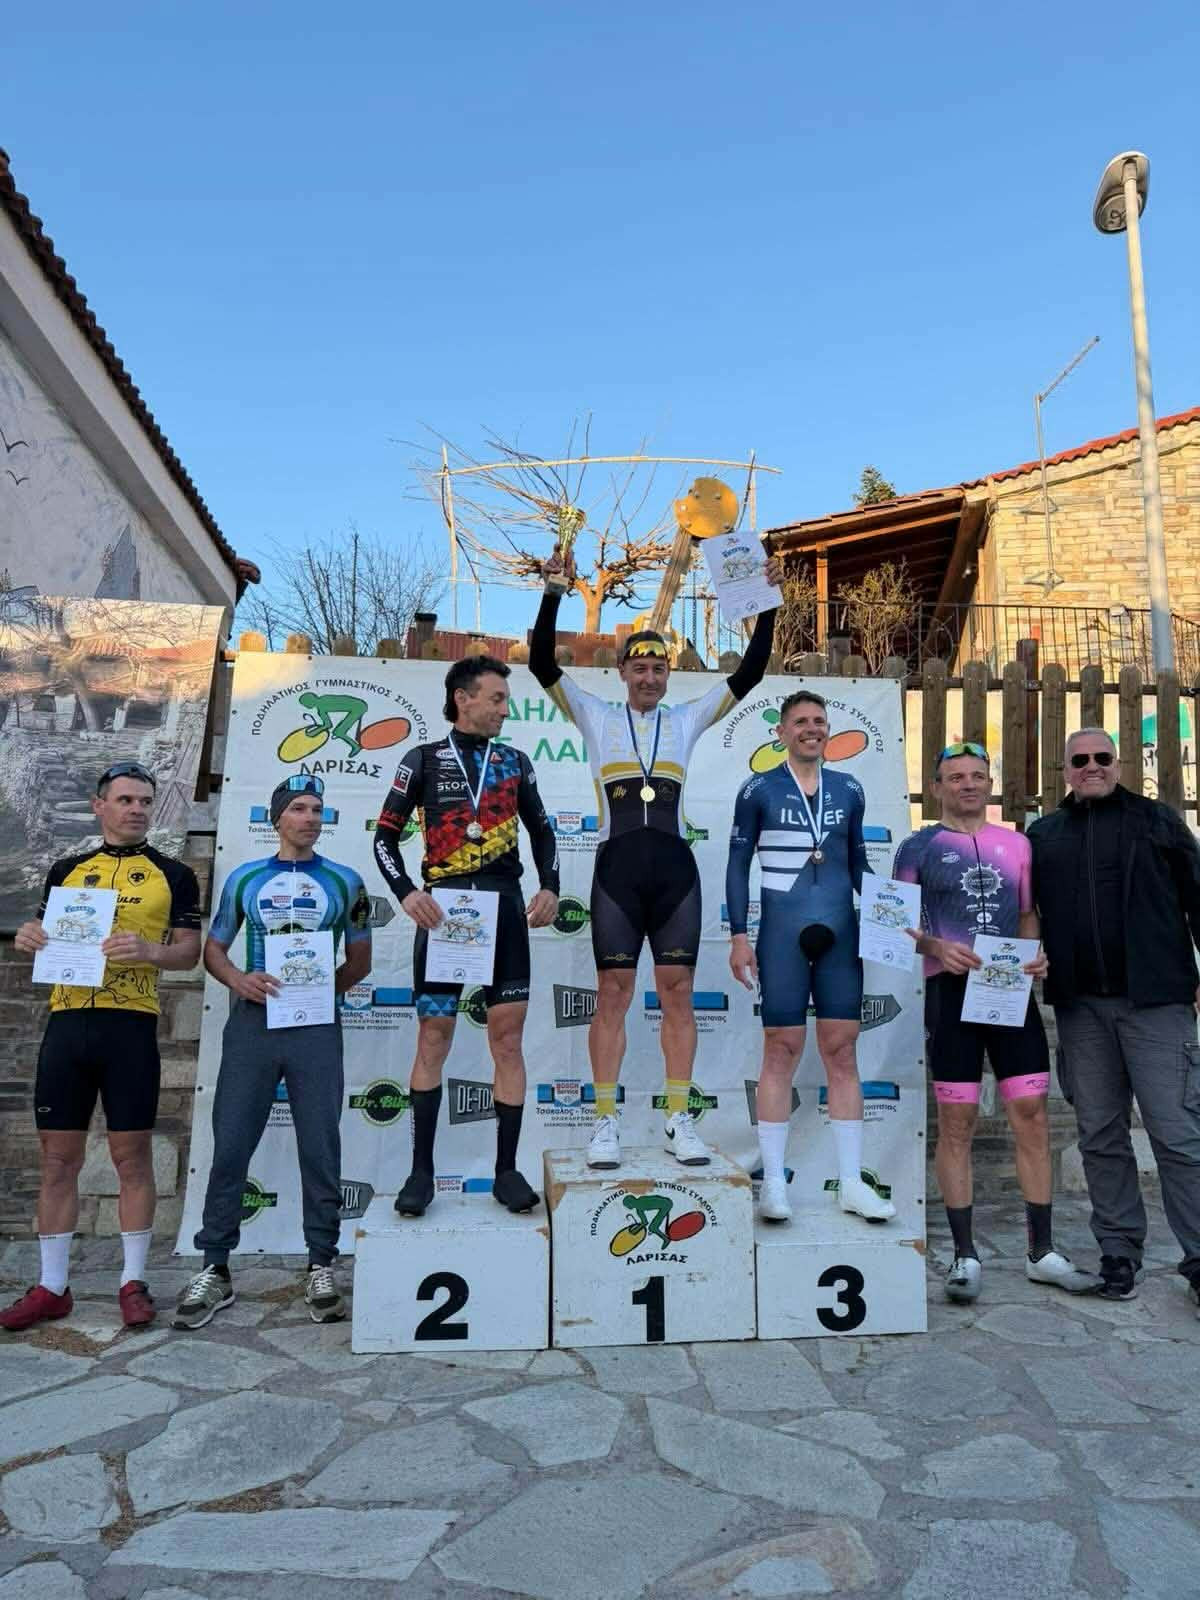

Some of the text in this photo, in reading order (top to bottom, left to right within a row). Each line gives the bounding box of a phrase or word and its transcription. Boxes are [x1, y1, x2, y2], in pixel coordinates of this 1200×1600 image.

[252, 679, 428, 741] ΠΟΔΗΛΑΤΙΚΟΣ ΓΥΜΝΑΣΤΙΚΟΣ ΣΥΛΛΟΓΟΣ
[723, 698, 771, 748] ΠΟΔΗΛΑΤΙΚΟΣ
[850, 707, 884, 752] ΣΥΛΛΟΓΟΣ
[300, 759, 383, 779] ΛΑΡΙΣΑΣ
[688, 1189, 718, 1227] ΣΥΛΛΟΓΟΣ
[626, 1252, 688, 1265] ΛΑΡΙΣΑΣ
[414, 1271, 469, 1341] 2
[631, 1275, 665, 1342] 1
[815, 1264, 867, 1332] 3
